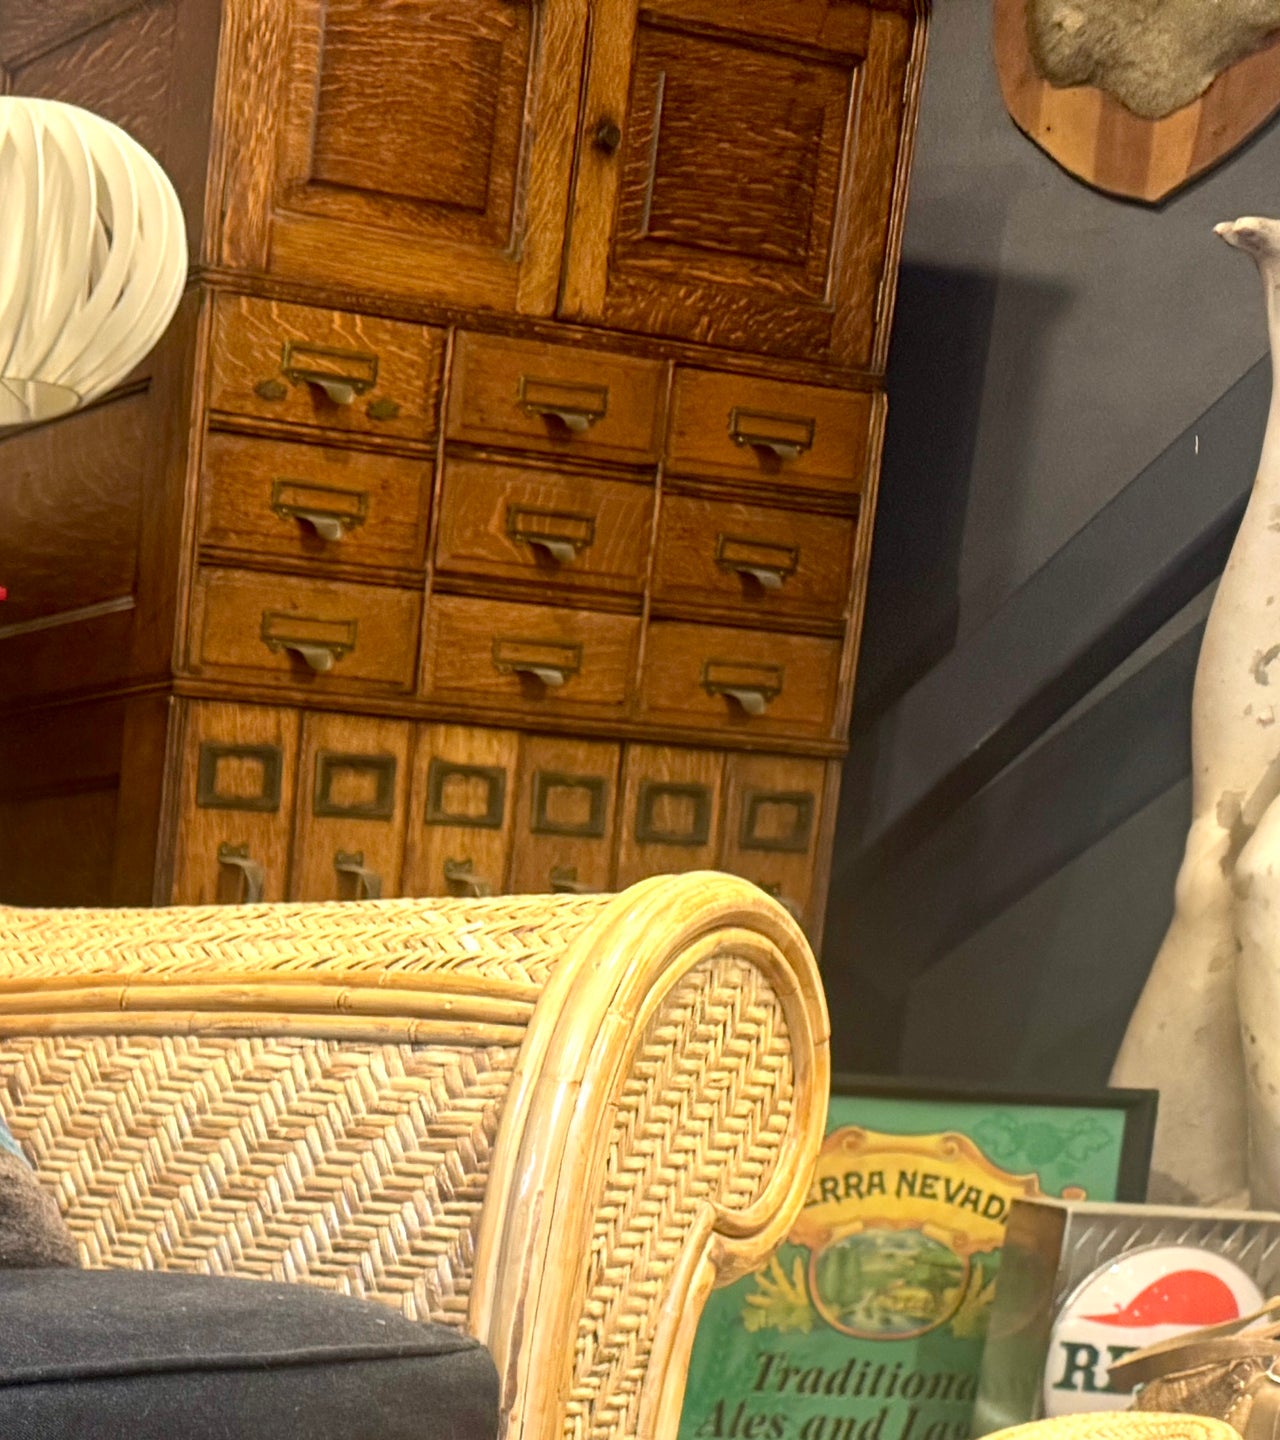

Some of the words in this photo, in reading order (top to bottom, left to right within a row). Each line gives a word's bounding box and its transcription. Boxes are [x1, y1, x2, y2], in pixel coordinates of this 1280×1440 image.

[804, 1170, 887, 1208] RRA
[895, 1168, 1008, 1225] NEVAD
[752, 1351, 980, 1401] Traditiona
[694, 1398, 789, 1440] Ales
